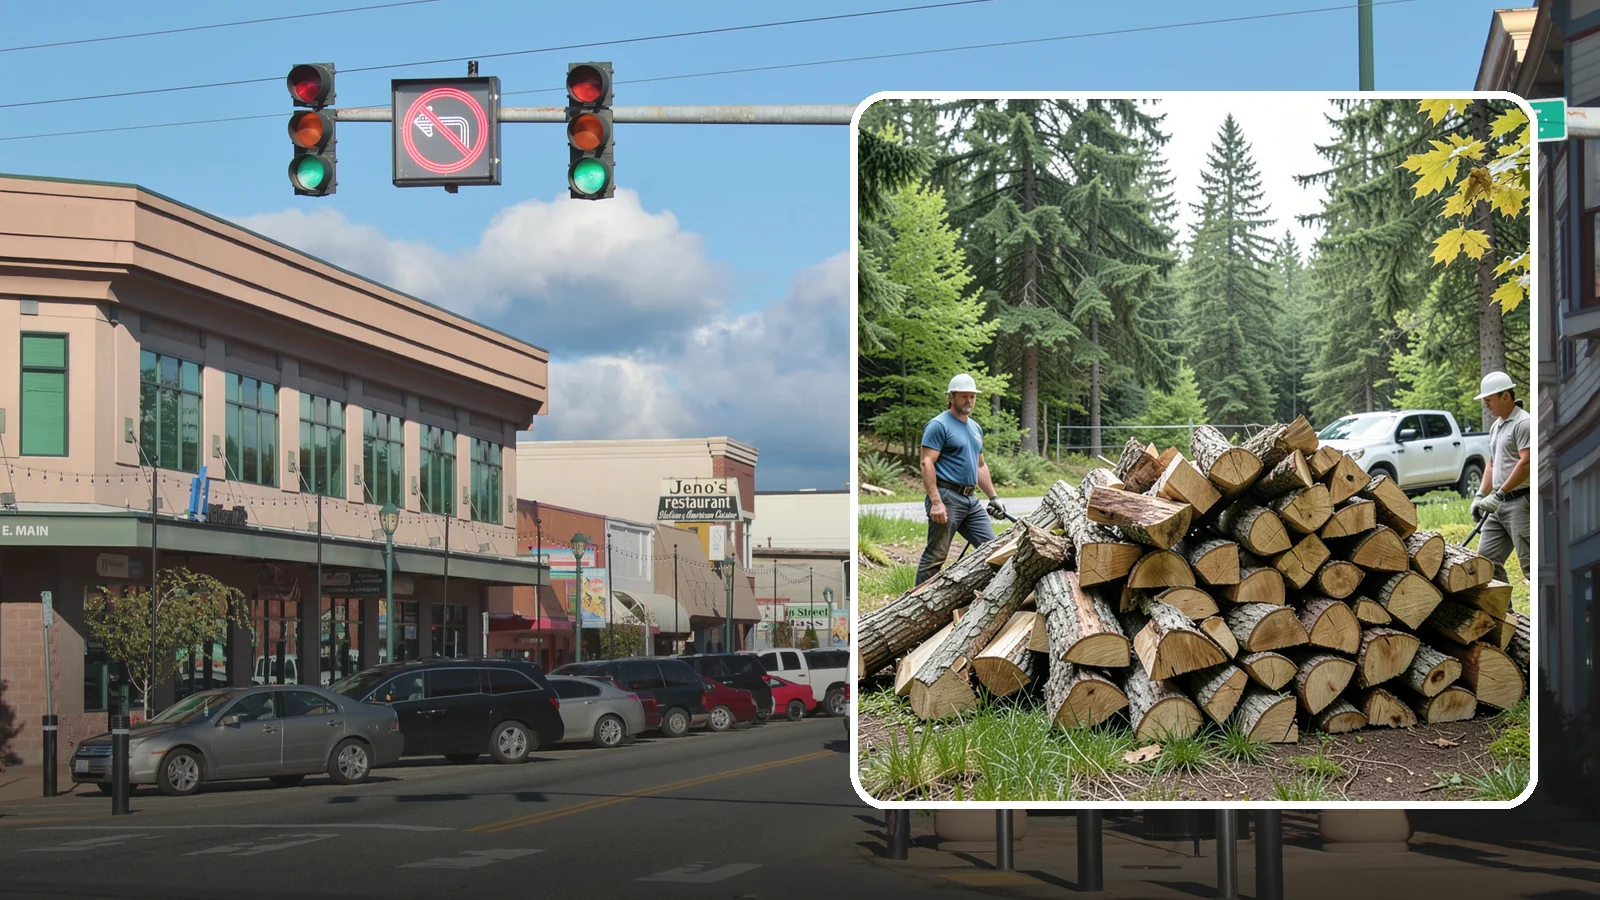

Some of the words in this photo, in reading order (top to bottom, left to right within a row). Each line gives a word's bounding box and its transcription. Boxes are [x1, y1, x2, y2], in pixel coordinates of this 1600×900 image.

[669, 480, 727, 494] Jeno's
[665, 496, 731, 508] restaurant
[658, 510, 681, 520] Italian
[686, 510, 715, 519] American
[715, 510, 737, 519] Cuisine
[2, 525, 13, 536] E.
[15, 525, 49, 536] MAIN
[797, 607, 828, 617] Street
